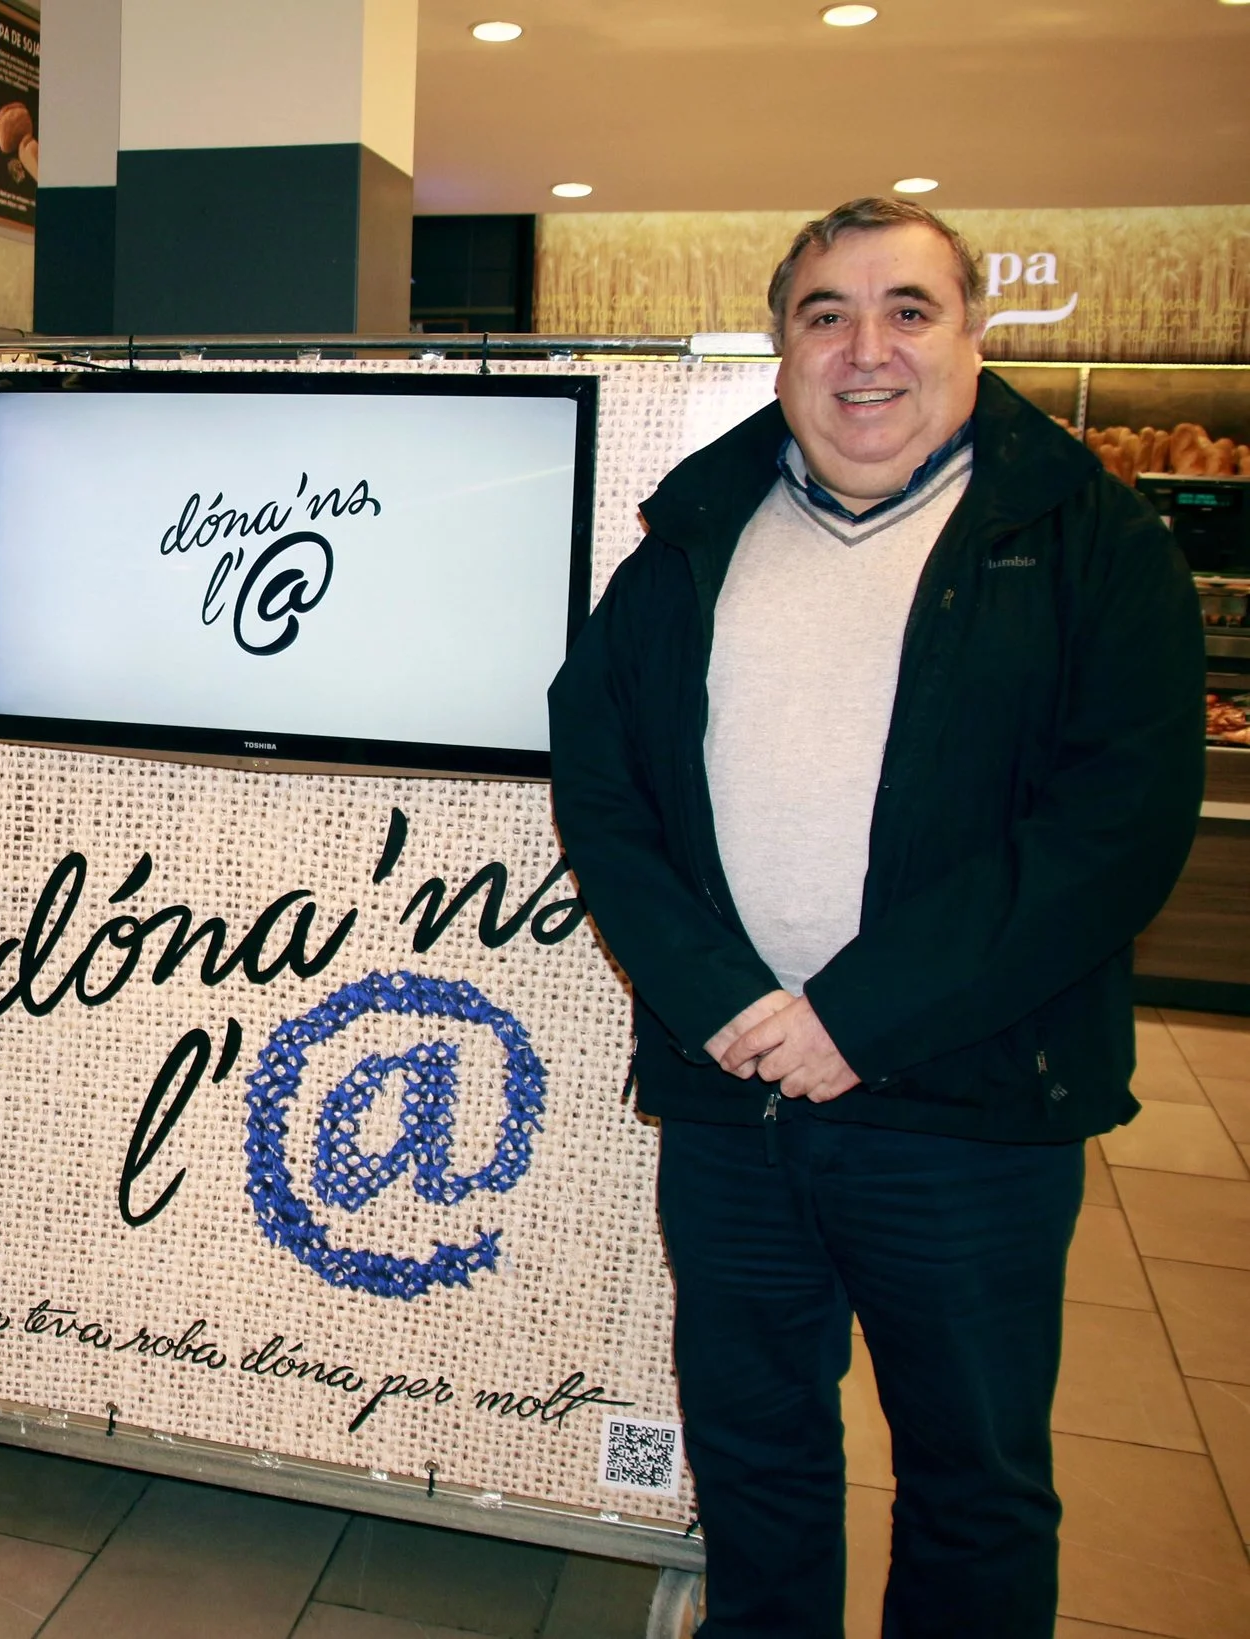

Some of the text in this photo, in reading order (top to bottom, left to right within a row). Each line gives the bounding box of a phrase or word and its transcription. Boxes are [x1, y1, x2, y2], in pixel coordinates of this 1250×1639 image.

[11, 29, 21, 48] DE
[986, 252, 1059, 296] pa
[160, 472, 382, 556] dóna'ns
[244, 741, 277, 750] TOSHIBA
[25, 1300, 112, 1350] teva
[116, 1319, 227, 1369] roba
[241, 1335, 364, 1393] dóna
[349, 1370, 454, 1433] per
[475, 1371, 634, 1429] molt
